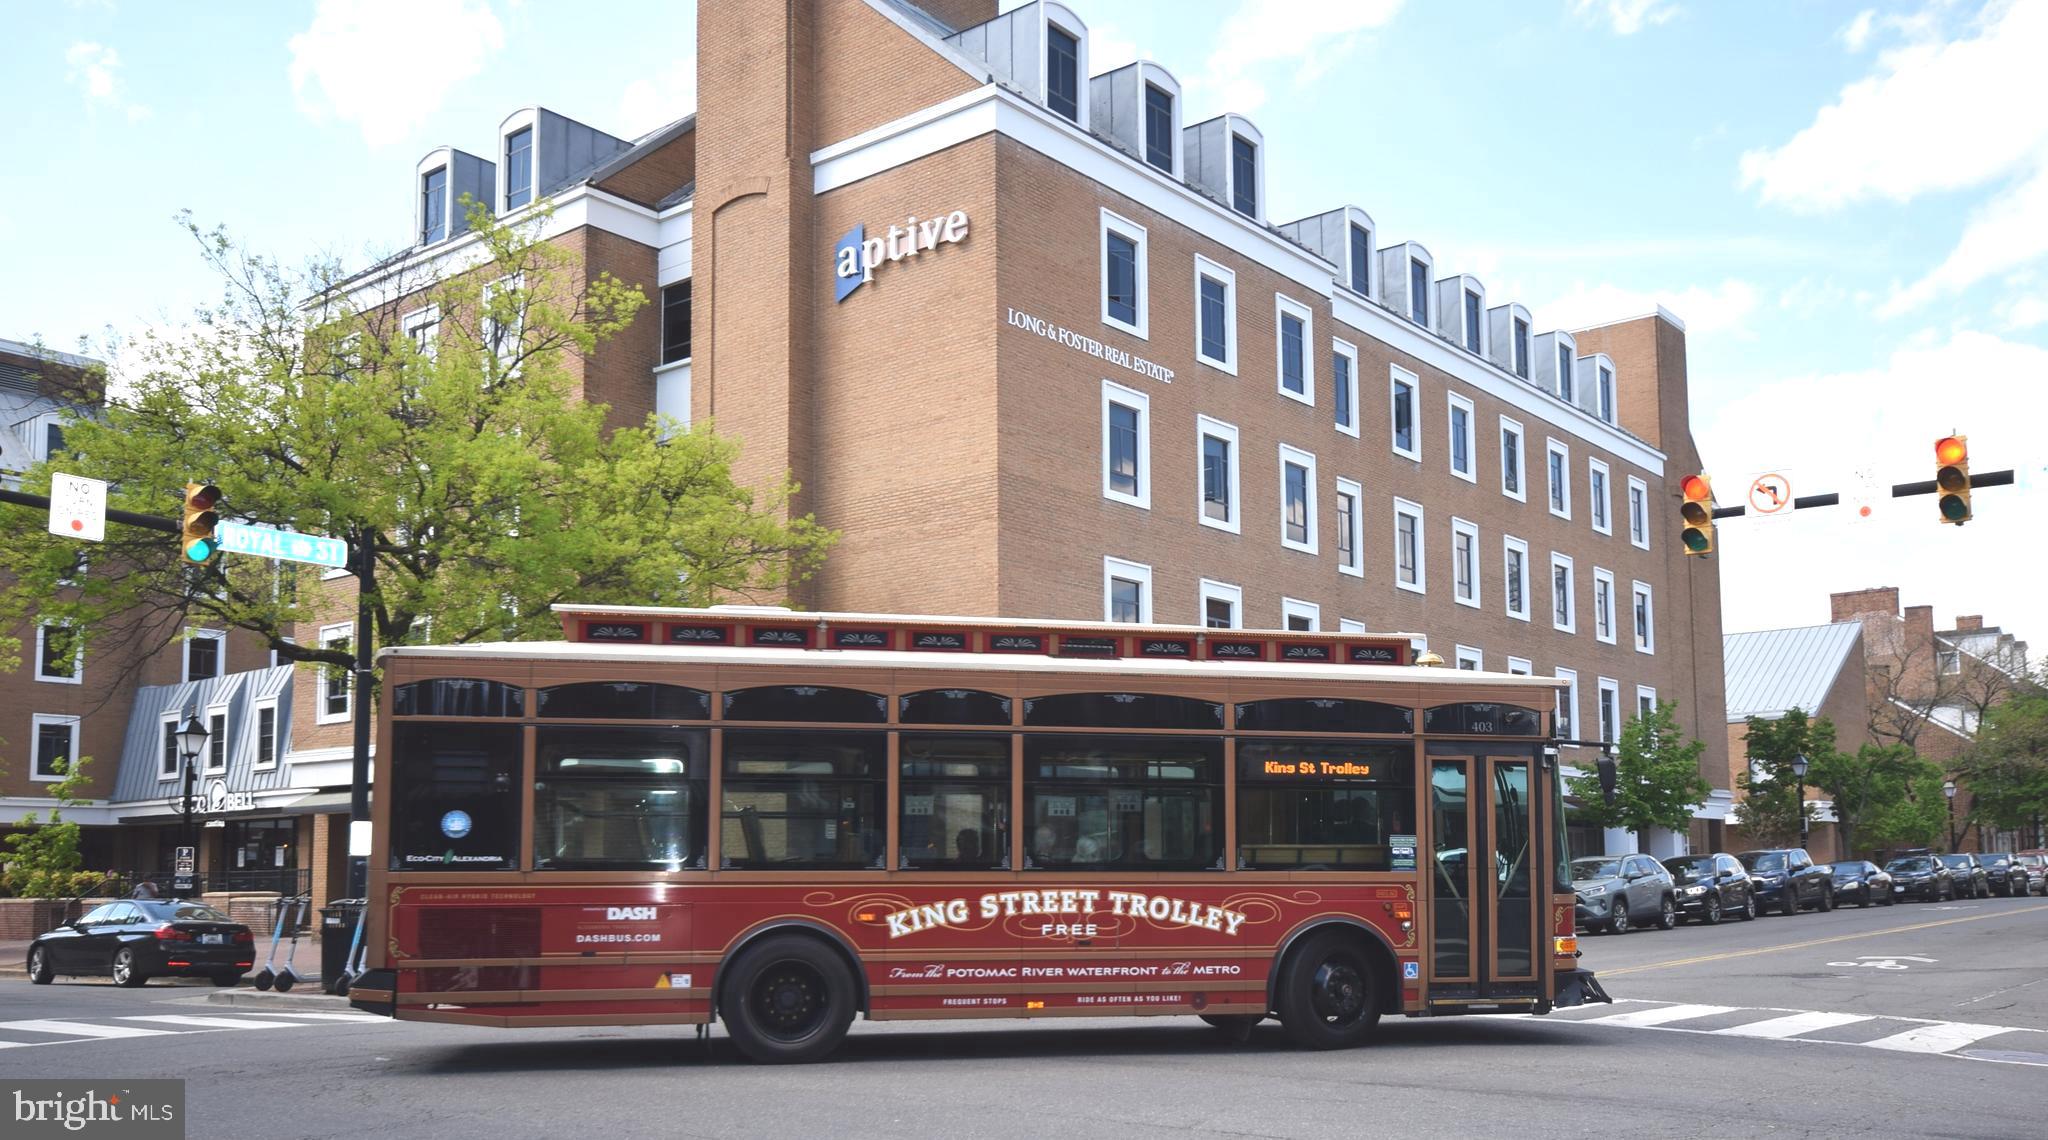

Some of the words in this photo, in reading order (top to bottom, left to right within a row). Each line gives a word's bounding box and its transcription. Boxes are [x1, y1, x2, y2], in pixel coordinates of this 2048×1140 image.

[837, 210, 969, 282] aptive
[1007, 307, 1047, 337] LONG
[1047, 324, 1058, 342] &
[1058, 327, 1104, 360] FOSTER
[1104, 345, 1133, 371] REAL
[69, 481, 90, 495] NO
[223, 525, 288, 555] ROYAL
[1471, 721, 1493, 732] 403
[1264, 761, 1296, 774] King
[1299, 761, 1317, 774] St
[1320, 761, 1370, 775] Trolley
[227, 791, 257, 811] BELL
[607, 907, 657, 920] DASH
[886, 898, 969, 938] KING
[980, 890, 1100, 919] STREET
[1108, 890, 1246, 936] TROLLEY
[1041, 923, 1097, 935] FREE
[576, 934, 661, 943] DASHBUS.COM
[889, 967, 924, 978] From
[947, 968, 1017, 977] POTOMAC
[1067, 966, 1158, 976] WATERFRONT
[1161, 966, 1172, 975] to
[1193, 965, 1241, 974] METRO
